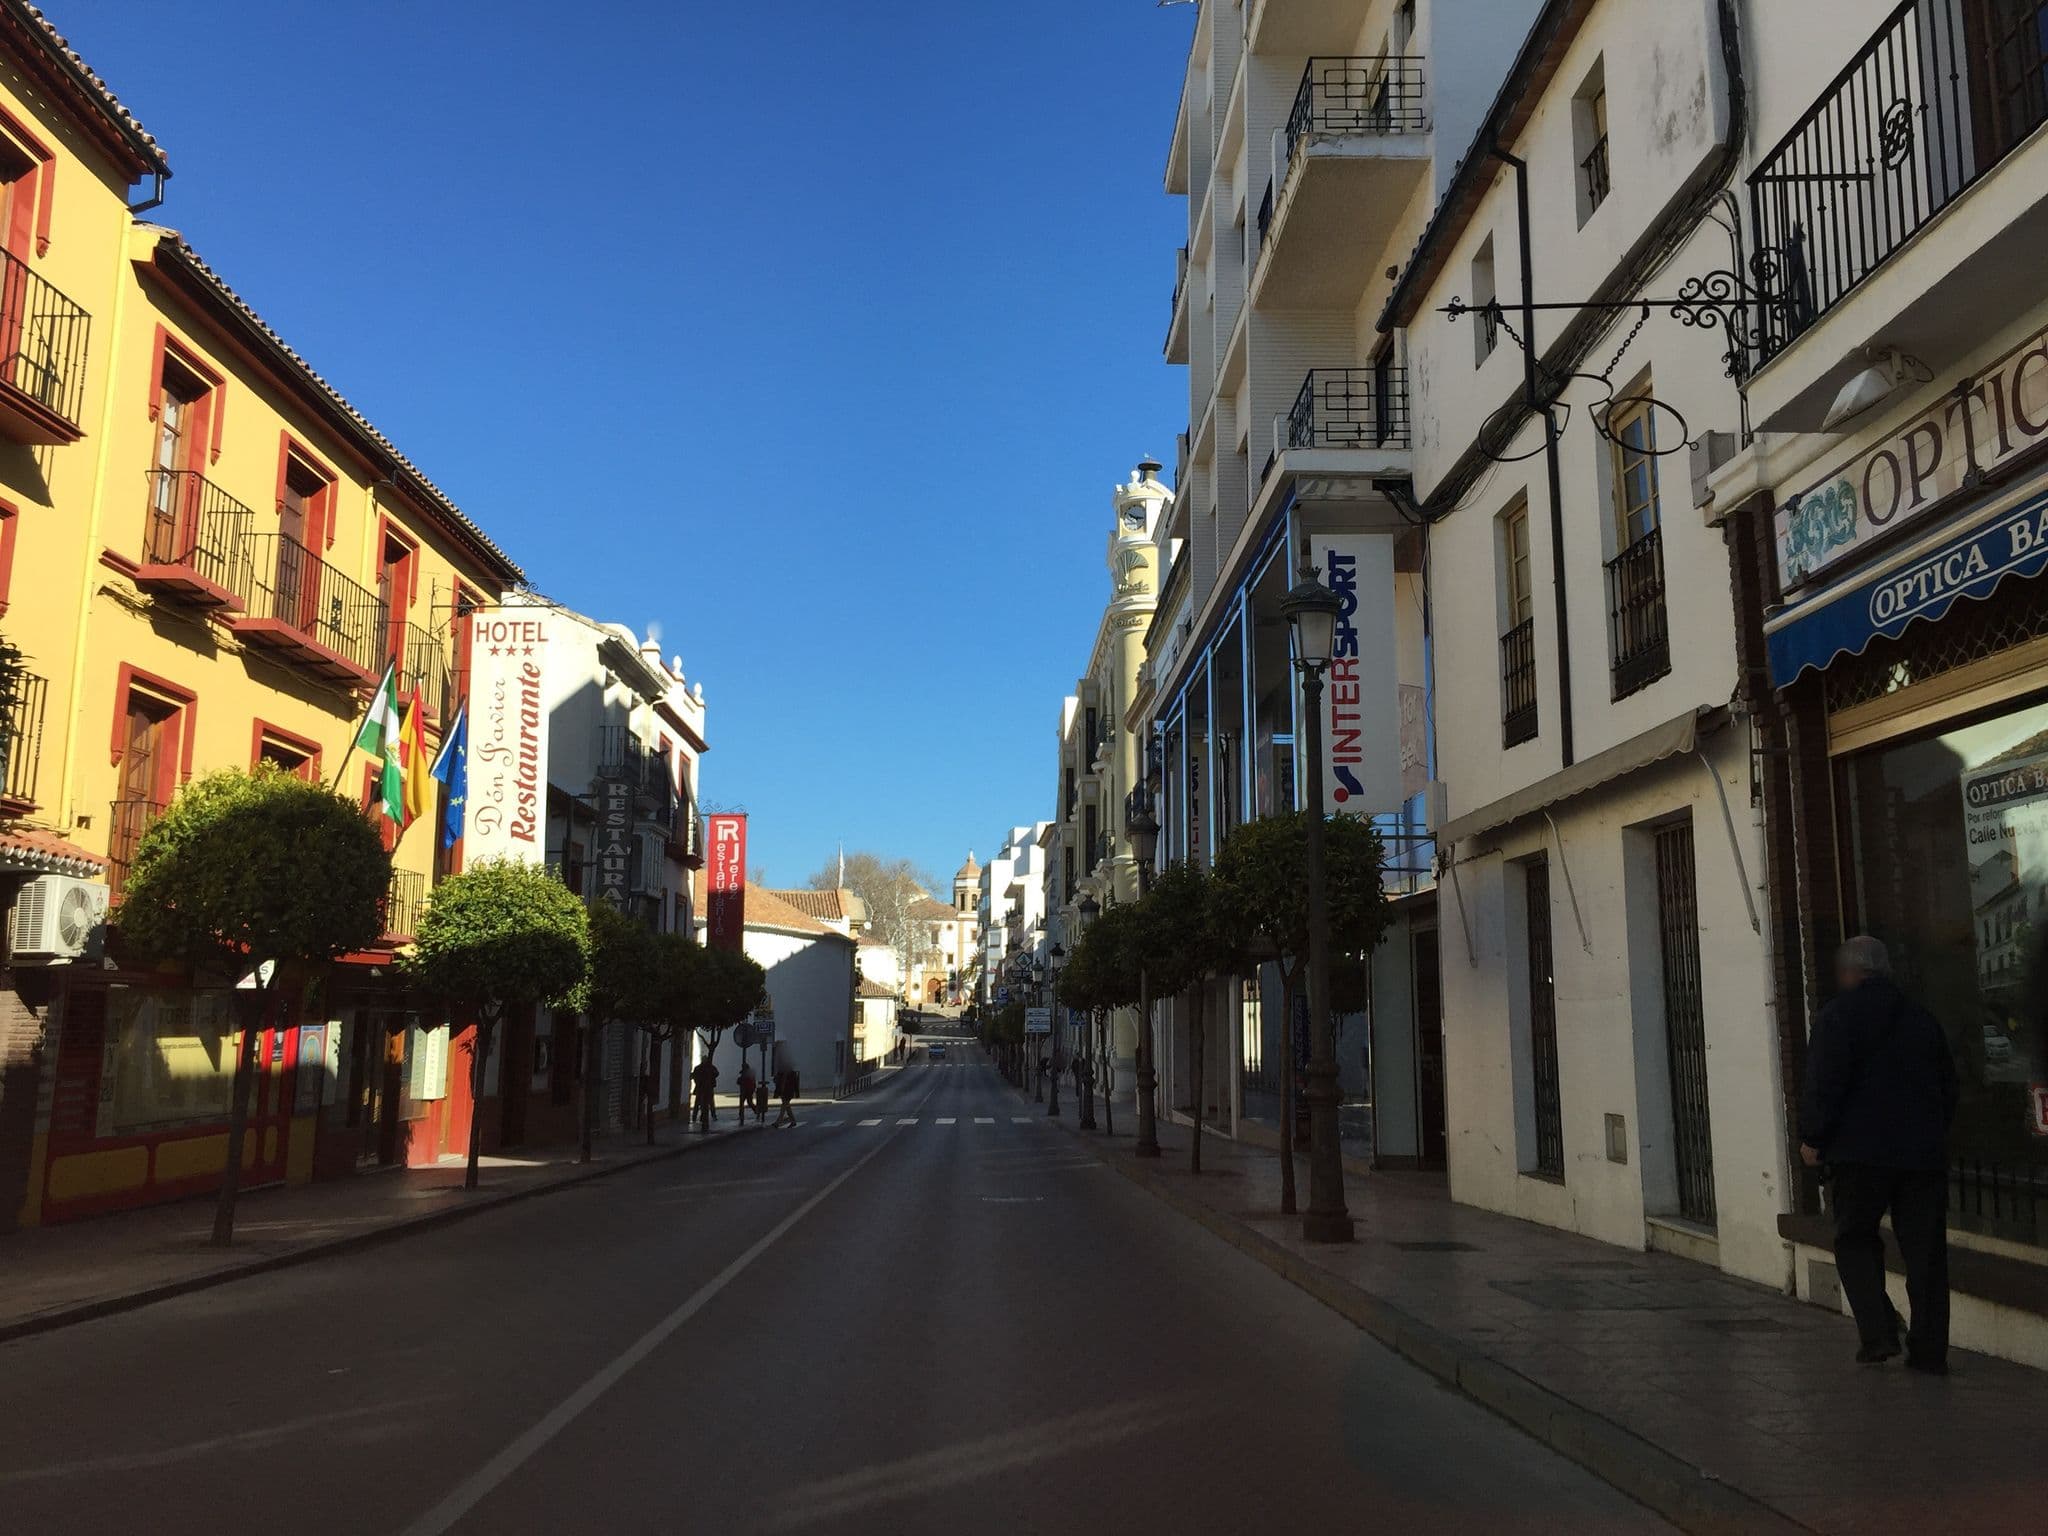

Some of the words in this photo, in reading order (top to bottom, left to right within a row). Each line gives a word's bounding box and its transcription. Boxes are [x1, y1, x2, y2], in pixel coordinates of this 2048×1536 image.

[1875, 543, 1989, 619] OPTICA
[475, 621, 549, 643] HOTEL
[1327, 549, 1363, 763] INTERSPORT
[510, 660, 541, 844] Restaurante
[1969, 775, 2027, 803] OPTICA
[2034, 770, 2048, 789] B
[1969, 825, 1997, 845] Calle
[729, 842, 740, 901] Jerez
